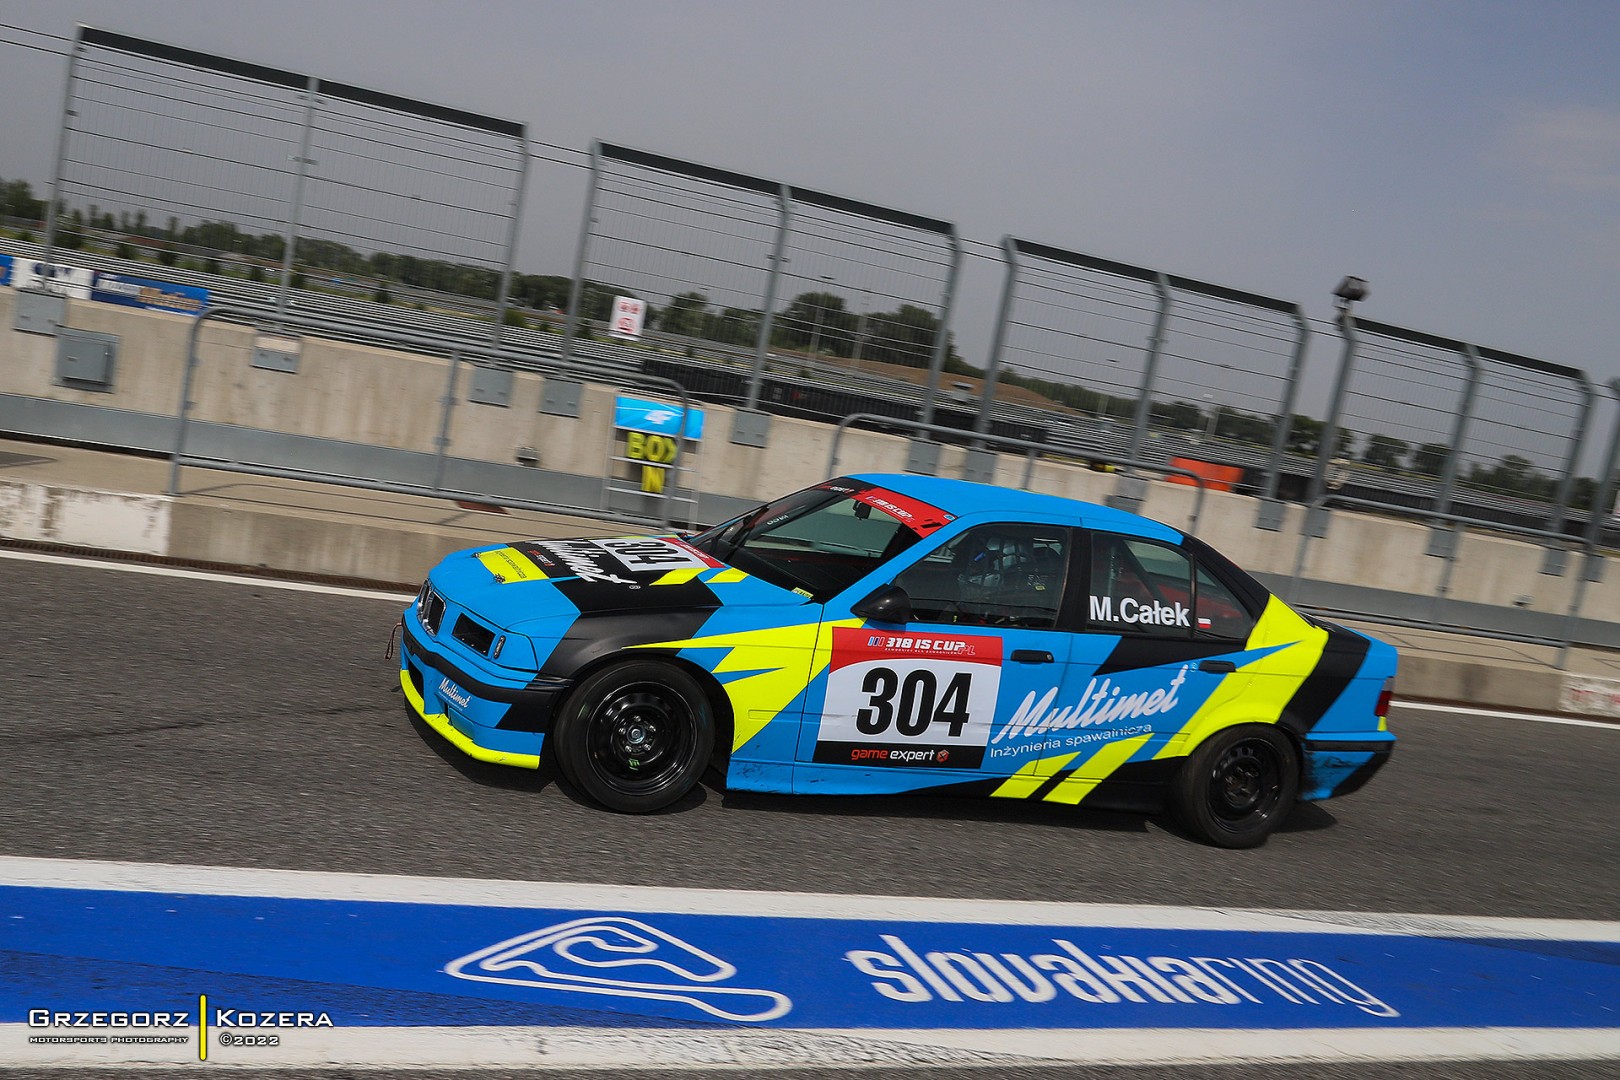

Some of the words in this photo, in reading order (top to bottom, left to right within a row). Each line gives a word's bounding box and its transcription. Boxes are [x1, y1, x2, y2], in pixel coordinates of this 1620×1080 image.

[604, 541, 692, 564] 304
[1089, 595, 1191, 627] M.Całek
[886, 637, 914, 648] 318
[914, 639, 932, 650] IS
[932, 640, 966, 651] CUP
[856, 667, 972, 737] 304
[990, 664, 1189, 744] Multimet
[851, 749, 888, 761] game
[889, 748, 935, 762] expert
[990, 735, 1061, 758] Inżynieria
[1065, 723, 1153, 747] spawalnicza
